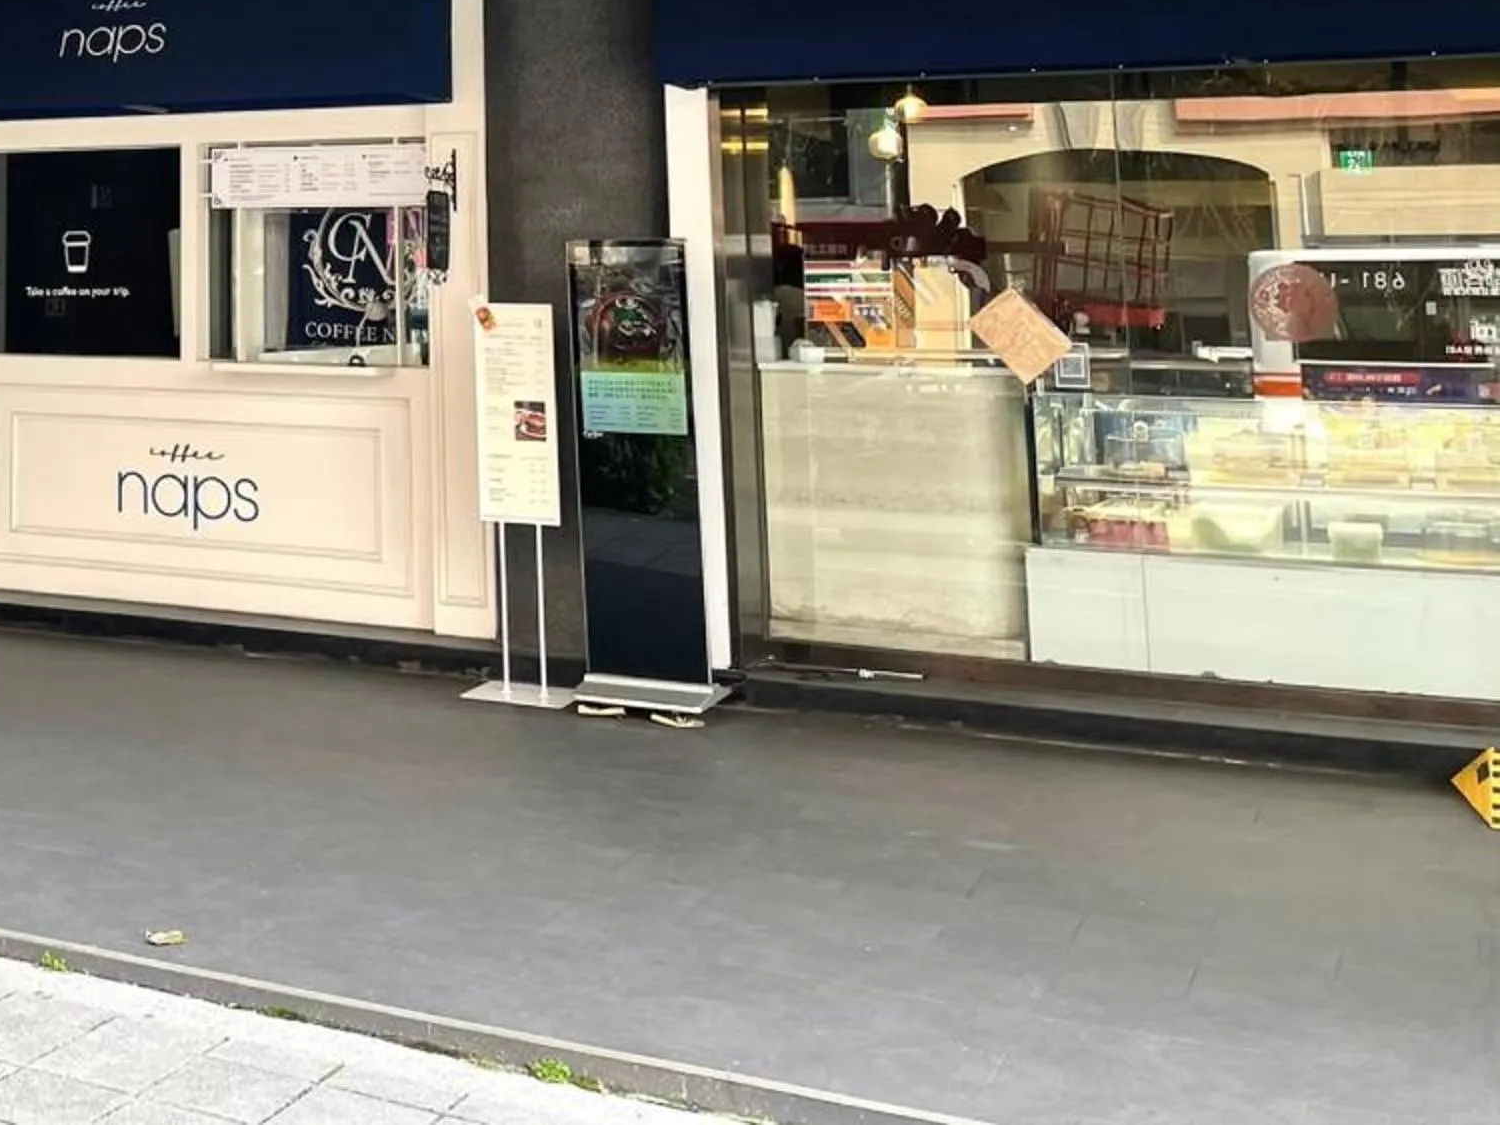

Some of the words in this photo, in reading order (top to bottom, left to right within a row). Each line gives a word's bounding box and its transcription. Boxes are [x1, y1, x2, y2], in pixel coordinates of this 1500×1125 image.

[59, 23, 167, 63] naps
[305, 322, 377, 341] COFFEE
[149, 443, 225, 463] coffee
[117, 471, 259, 531] naps
